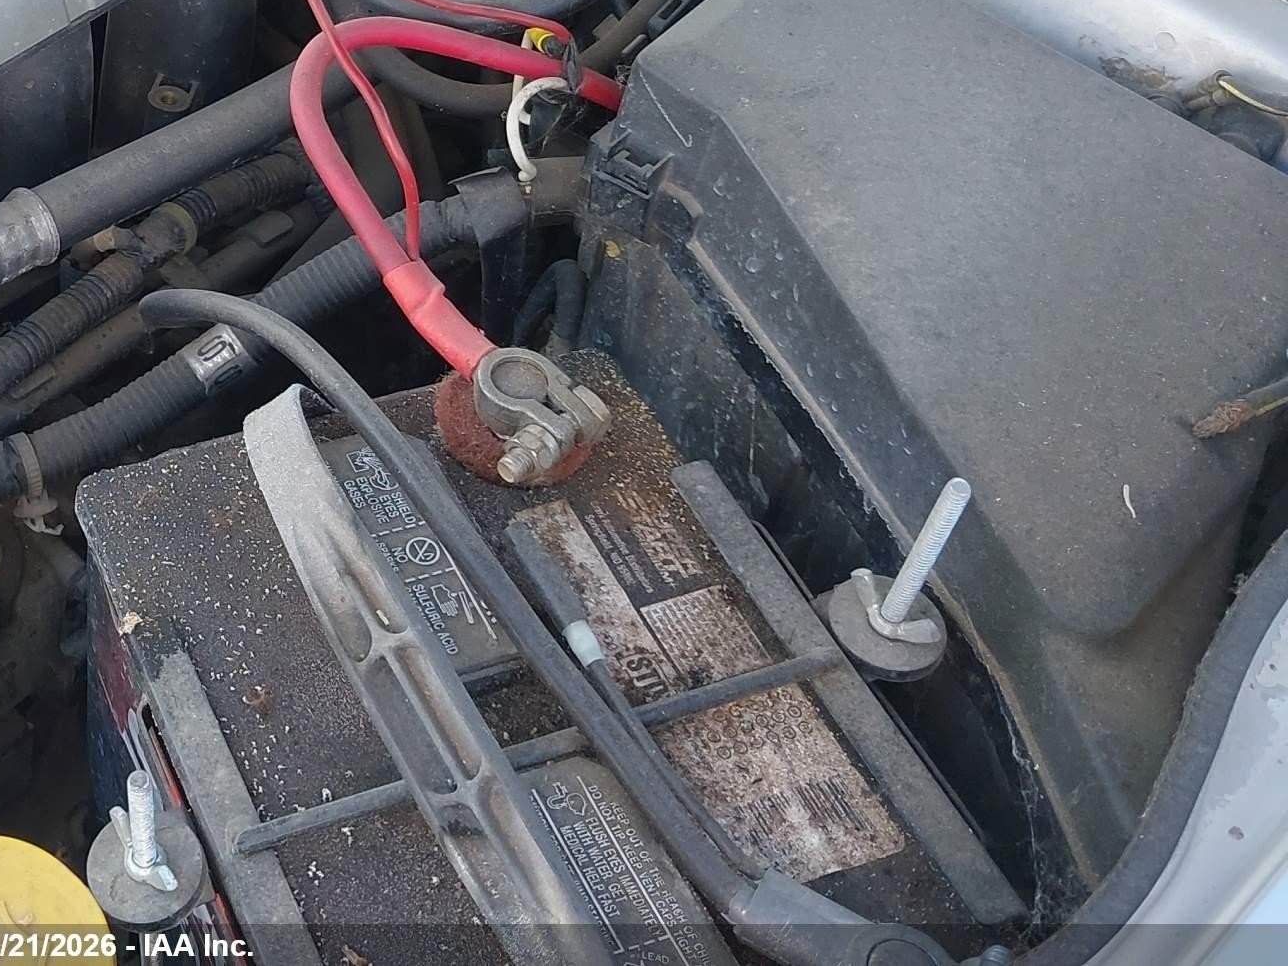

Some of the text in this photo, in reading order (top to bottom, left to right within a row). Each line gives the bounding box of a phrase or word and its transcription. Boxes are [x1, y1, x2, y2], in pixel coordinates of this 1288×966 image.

[342, 479, 366, 509] GASES
[355, 476, 389, 525] EXPLOSIVE
[379, 494, 399, 518] EYES
[391, 490, 416, 525] SHIELD
[390, 545, 408, 564] NO
[412, 582, 445, 630] SULFURIC
[438, 631, 458, 655] ACID
[559, 825, 620, 919] MEDICAL HELP FAST
[572, 821, 594, 847] WITH
[607, 882, 626, 904] GET
[584, 816, 664, 939] FLUSH EYES IMMEDIATELY
[587, 784, 602, 800] DO
[596, 801, 614, 822] NOT
[621, 844, 643, 871] KEEP
[637, 872, 659, 898] VENT
[654, 900, 676, 927] CAPS
[672, 930, 697, 962] TIGHT
[610, 800, 629, 827] KEEP
[624, 827, 643, 848] OUT
[638, 850, 653, 866] OF
[647, 867, 665, 887] THE
[660, 889, 687, 923] REACH
[682, 924, 697, 940] OF
[642, 951, 670, 964] LEAD
